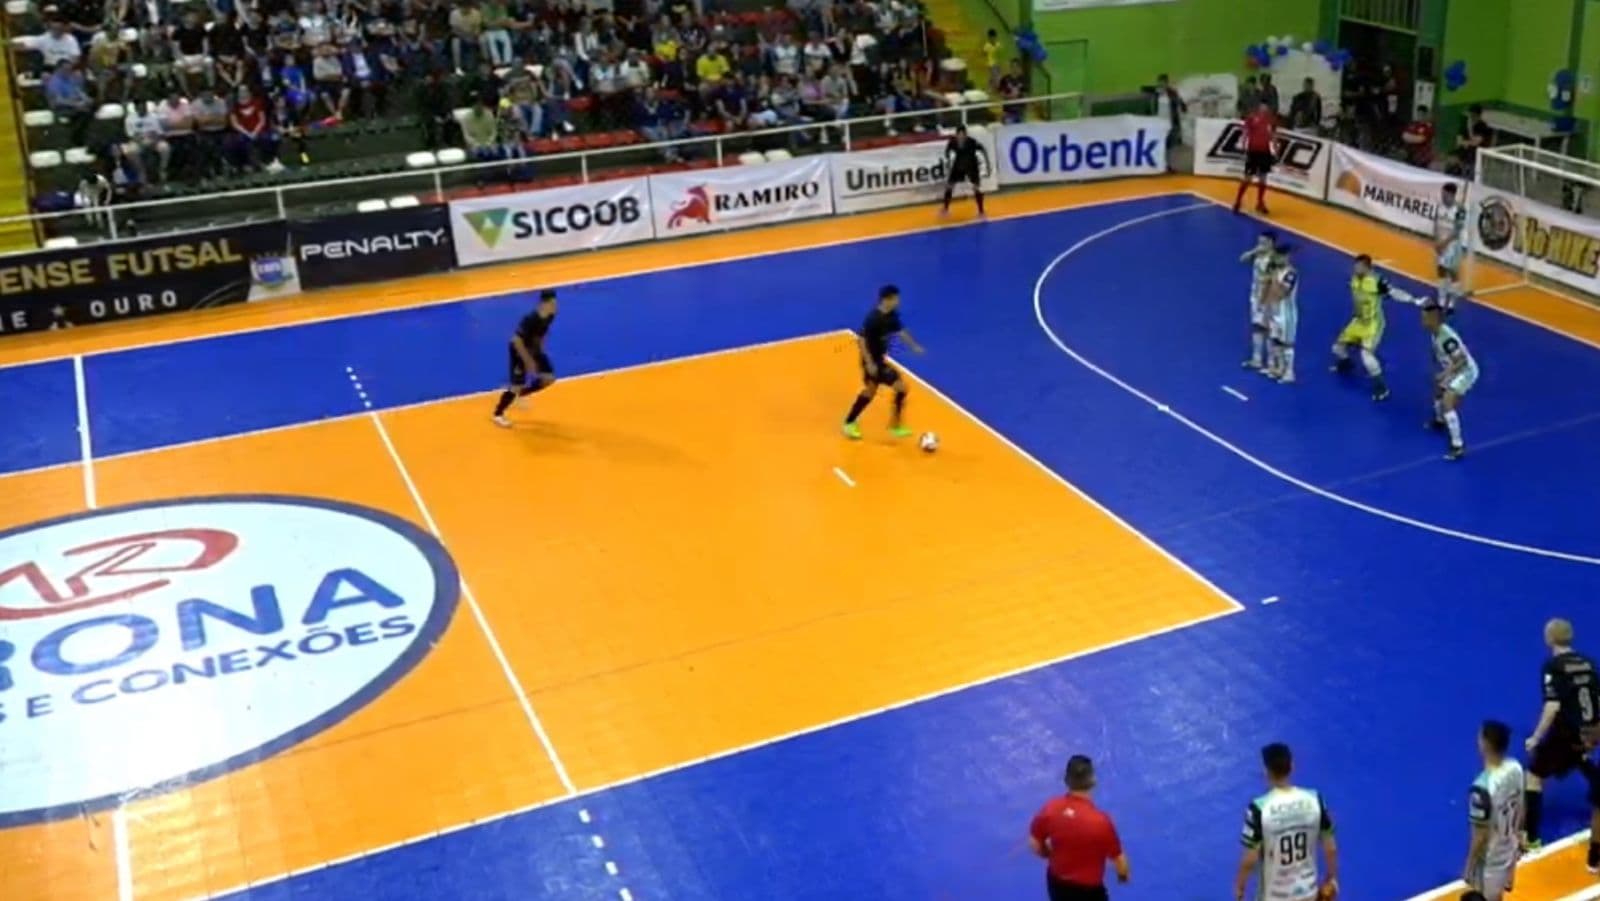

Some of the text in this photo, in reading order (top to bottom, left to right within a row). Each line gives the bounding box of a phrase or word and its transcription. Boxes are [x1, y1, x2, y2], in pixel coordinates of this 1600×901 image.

[1010, 129, 1159, 174] Orbenk
[845, 158, 946, 191] Unimed
[715, 182, 819, 211] RAMIRO
[512, 196, 640, 240] SICOOB
[301, 229, 445, 261] PENALTY
[0, 238, 243, 295] ENSE FUTSAL
[90, 290, 178, 318] OURO
[0, 568, 405, 692] ONA
[26, 615, 416, 718] E CONEXÕES
[1578, 687, 1594, 722] 9
[1280, 832, 1307, 866] 99
